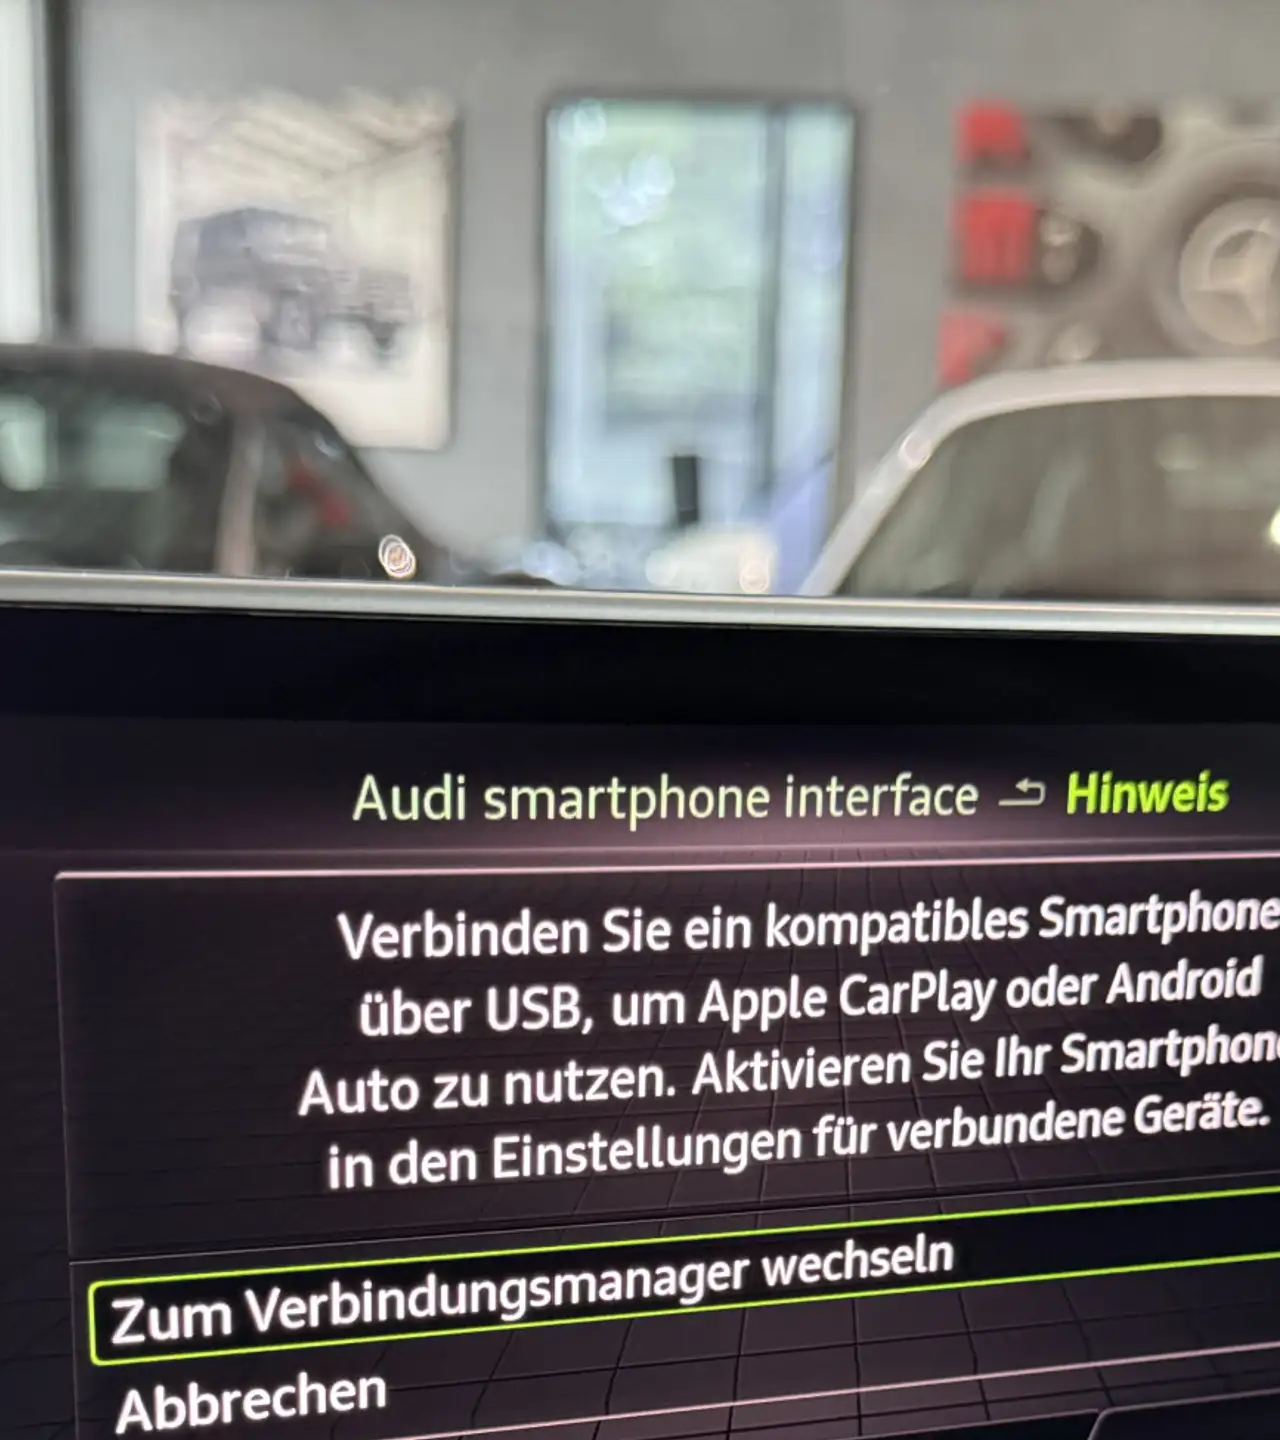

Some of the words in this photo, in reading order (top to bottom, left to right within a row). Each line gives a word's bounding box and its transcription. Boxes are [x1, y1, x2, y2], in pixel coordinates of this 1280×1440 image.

[353, 773, 465, 820] Audi
[484, 773, 770, 832] smartphone
[783, 772, 979, 819] interface
[1067, 771, 1228, 814] Hinweis
[337, 907, 589, 960] Verbinden
[603, 907, 672, 952] Sie
[684, 905, 752, 950] ein
[766, 896, 1029, 956] kompatibles
[360, 988, 472, 1036] über
[487, 984, 593, 1035] USB,
[612, 991, 685, 1026] um
[698, 974, 828, 1033] Apple
[840, 968, 997, 1022] CarPlay
[1006, 964, 1097, 1008] oder
[1106, 955, 1263, 1004] Android
[298, 1069, 419, 1116] Auto
[433, 1073, 489, 1109] zu
[505, 1060, 675, 1105] nutzen.
[692, 1046, 911, 1095] Aktivieren
[922, 1039, 985, 1081] Sie
[995, 1034, 1052, 1077] Ihr
[329, 1144, 373, 1189] in
[388, 1138, 477, 1185] den
[493, 1124, 802, 1179] Einstellungen
[812, 1114, 878, 1157] für
[886, 1100, 1126, 1152] verbundene
[1134, 1091, 1270, 1134] Geräte.
[112, 1298, 232, 1344] Zum
[244, 1257, 752, 1334] Verbindungsmanager
[760, 1233, 956, 1284] wechseln
[116, 1371, 386, 1434] Abbrechen
